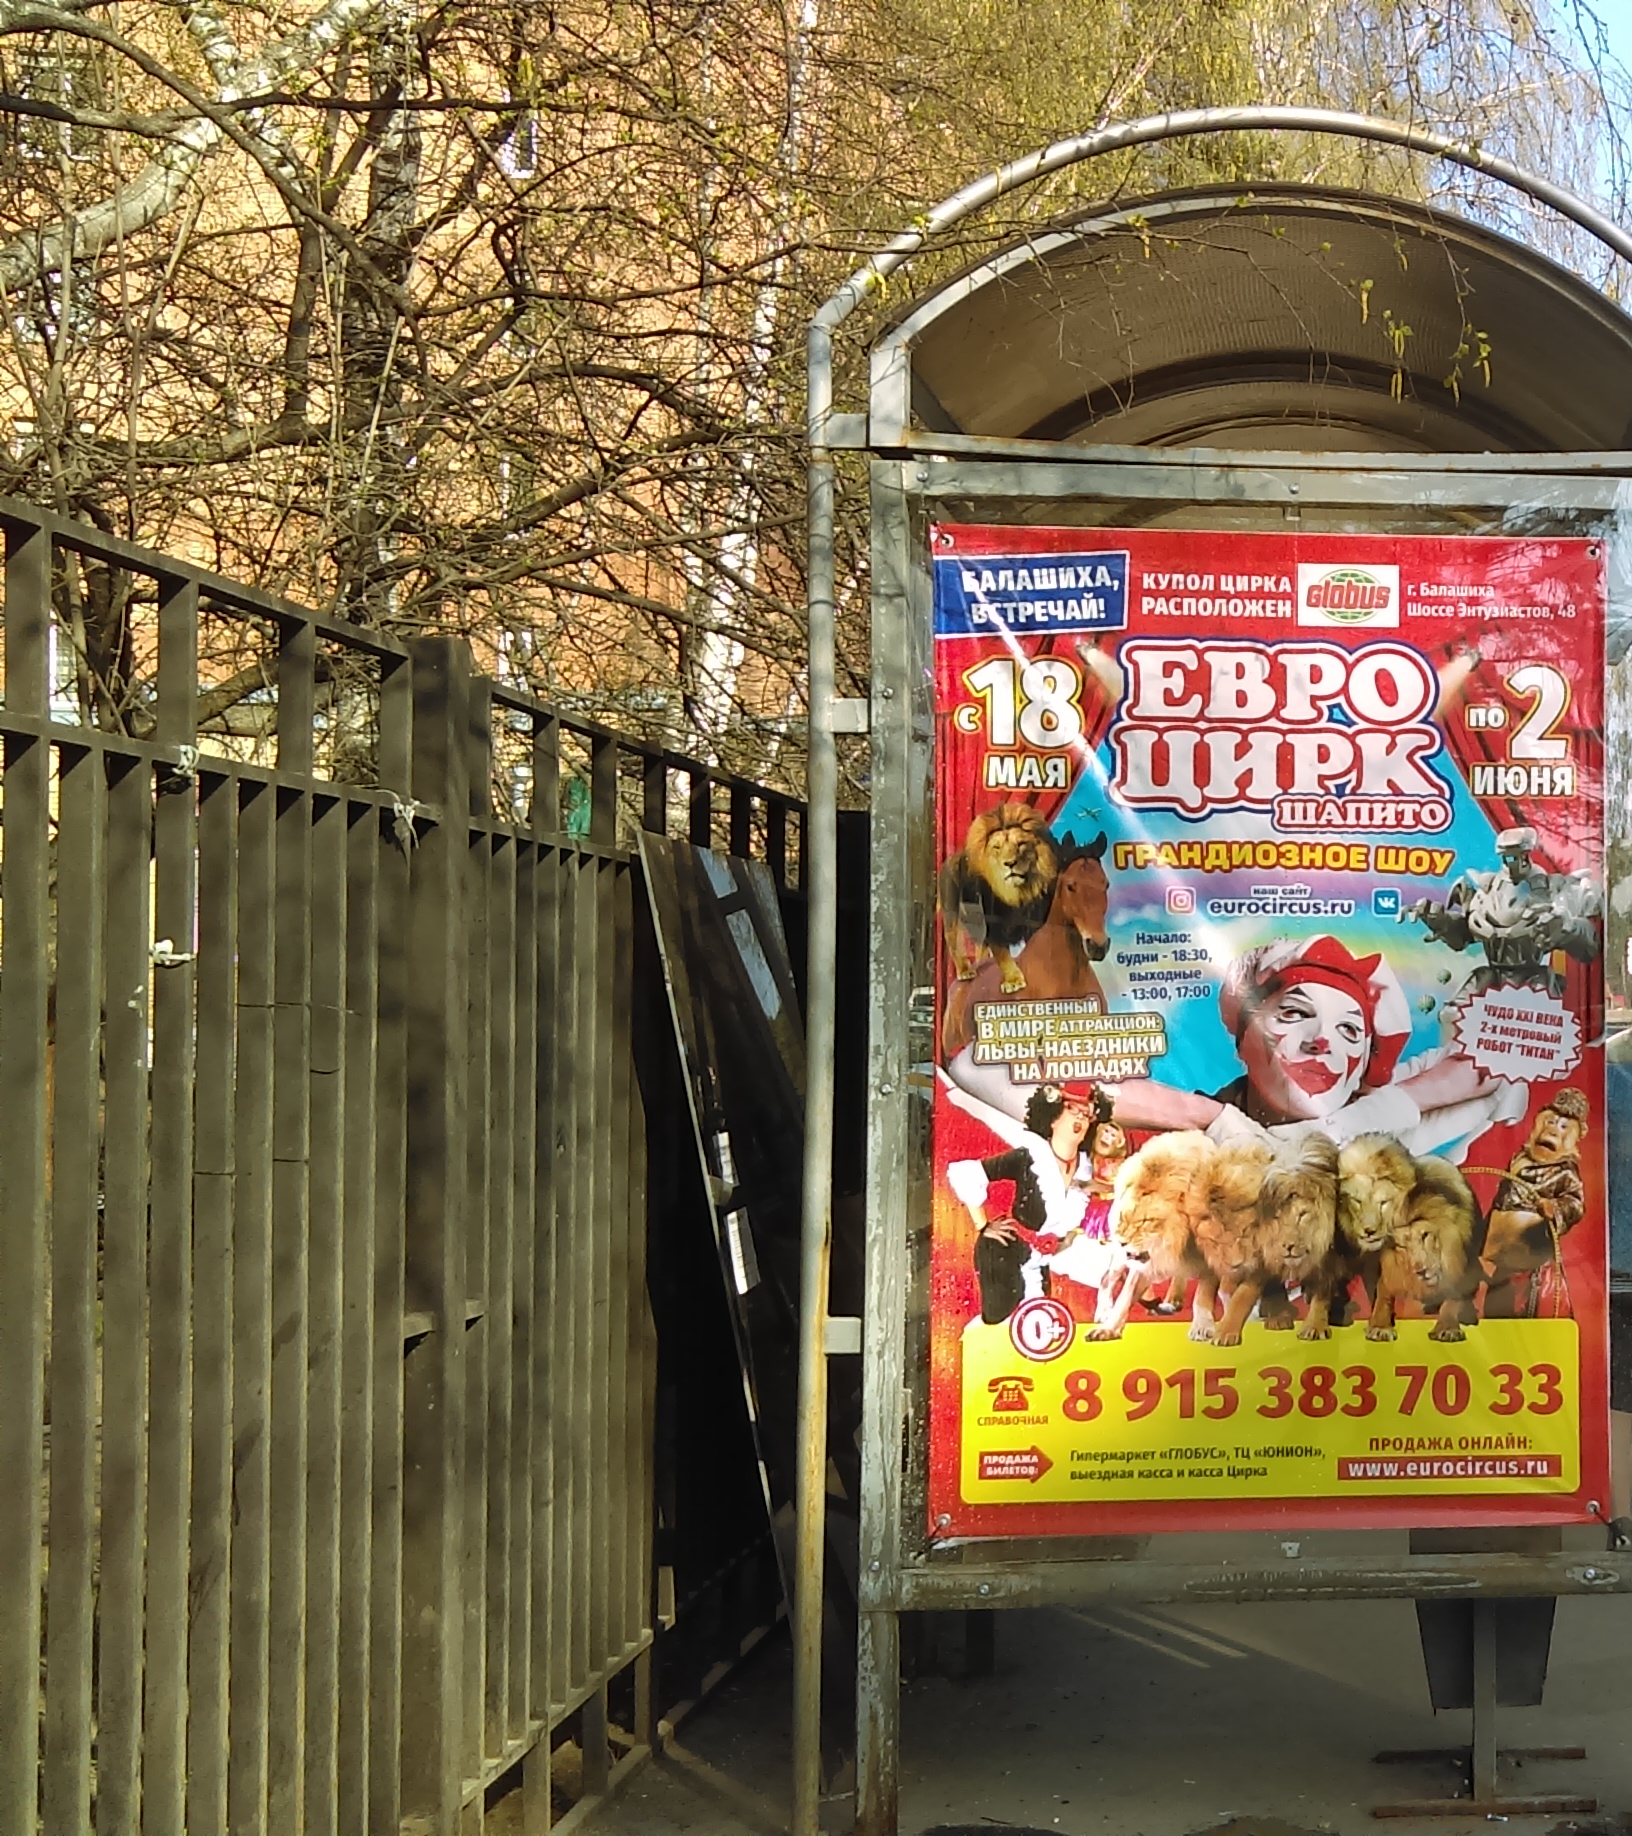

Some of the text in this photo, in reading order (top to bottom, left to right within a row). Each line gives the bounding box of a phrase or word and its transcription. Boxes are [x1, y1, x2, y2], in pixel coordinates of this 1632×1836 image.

[962, 566, 1119, 592] БАЛАШИХА,
[1143, 573, 1291, 594] КУПОЛ ЦИРКА
[1306, 580, 1391, 609] Globus
[1419, 583, 1494, 597] Балашиха
[972, 594, 1106, 623] ВСТРЕЧАЙ!
[1142, 597, 1292, 618] РАСПОЛОЖЕН
[1407, 603, 1576, 621] Шоссе Энтузиастов, 48
[1131, 648, 1426, 721] ЕВРО
[956, 658, 1082, 748] с 18
[1468, 664, 1570, 759] по 2
[986, 757, 1068, 788] МАЯ
[1119, 729, 1447, 805] ЦИРК
[1473, 765, 1575, 796] ИЮНЯ
[1278, 801, 1447, 827] ШАПИТО
[1115, 843, 1452, 874] ГРАНДИОЗНОЕ ШОУ
[1209, 898, 1353, 915] eurocircus.ru
[1135, 932, 1192, 945] Начало:
[1116, 950, 1159, 967] будни
[1171, 949, 1213, 963] 18:30,
[1129, 969, 1202, 983] выходные
[1131, 986, 1172, 1001] 13:00,
[1175, 985, 1211, 998] 17:00
[977, 998, 1098, 1020] ЕДИНСТВЕННЫЙ
[981, 1017, 1161, 1039] В МИРЕ АТТРАКЦИОН:
[1500, 1026, 1562, 1044] метровый
[977, 1036, 1163, 1060] ЛЬВЫ-НАЕЗДНИКИ
[1476, 1038, 1513, 1054] РОБОТ
[1014, 1058, 1145, 1080] НА ЛОШАДЯХ
[1020, 1312, 1066, 1343] 0+
[1062, 1364, 1563, 1421] 8 915 383 70 33
[977, 1416, 1049, 1426] СПРАВОЧНАЯ
[1369, 1433, 1533, 1453] ПРОДАЖА ОНЛАЙН:
[983, 1455, 1039, 1465] ПРОДАЖА
[1070, 1445, 1326, 1464] Гипермаркет «ГЛОБУС», ТЦ «ЮНИОН»,
[1070, 1465, 1268, 1481] выездная касса и касса Цирка
[1349, 1457, 1548, 1477] www.eurocircus.ru
